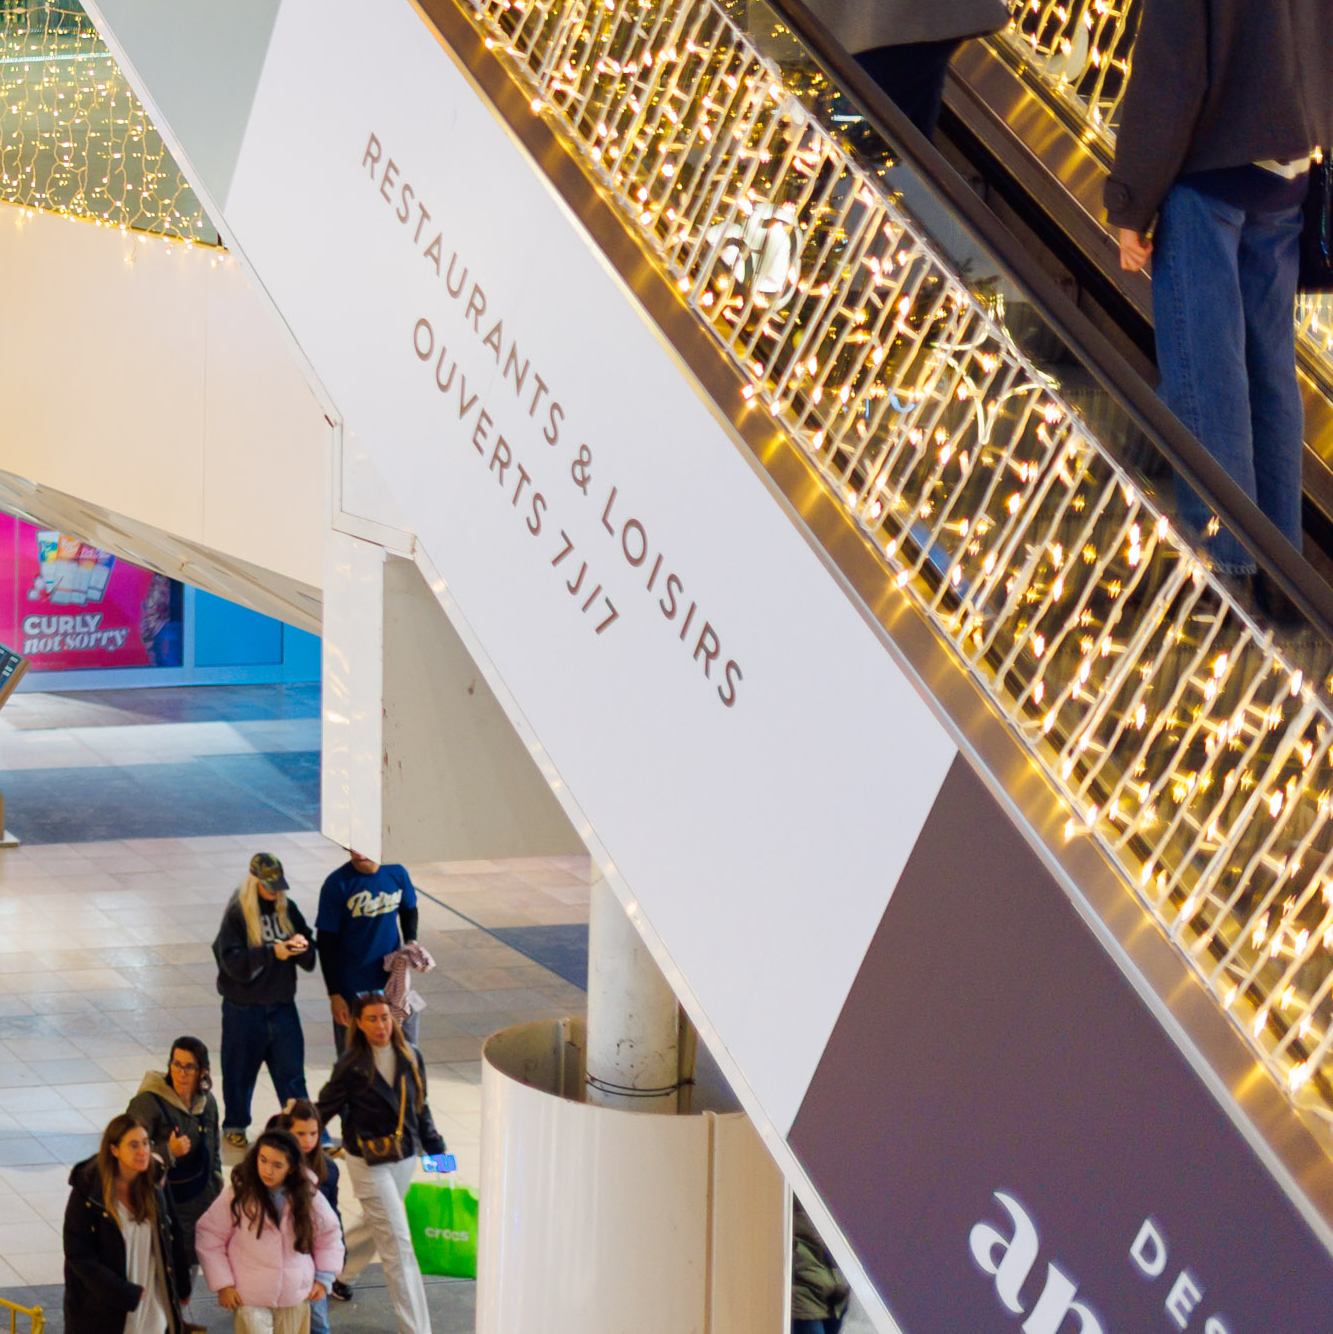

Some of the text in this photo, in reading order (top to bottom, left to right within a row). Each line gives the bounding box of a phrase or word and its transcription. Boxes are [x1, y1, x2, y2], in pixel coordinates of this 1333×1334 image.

[361, 132, 744, 709] RESTAURANTS & LOISIRS
[413, 317, 548, 537] OUVERTS
[23, 615, 102, 635] CURLY
[23, 628, 130, 655] not sorry
[424, 1226, 470, 1242] crocs
